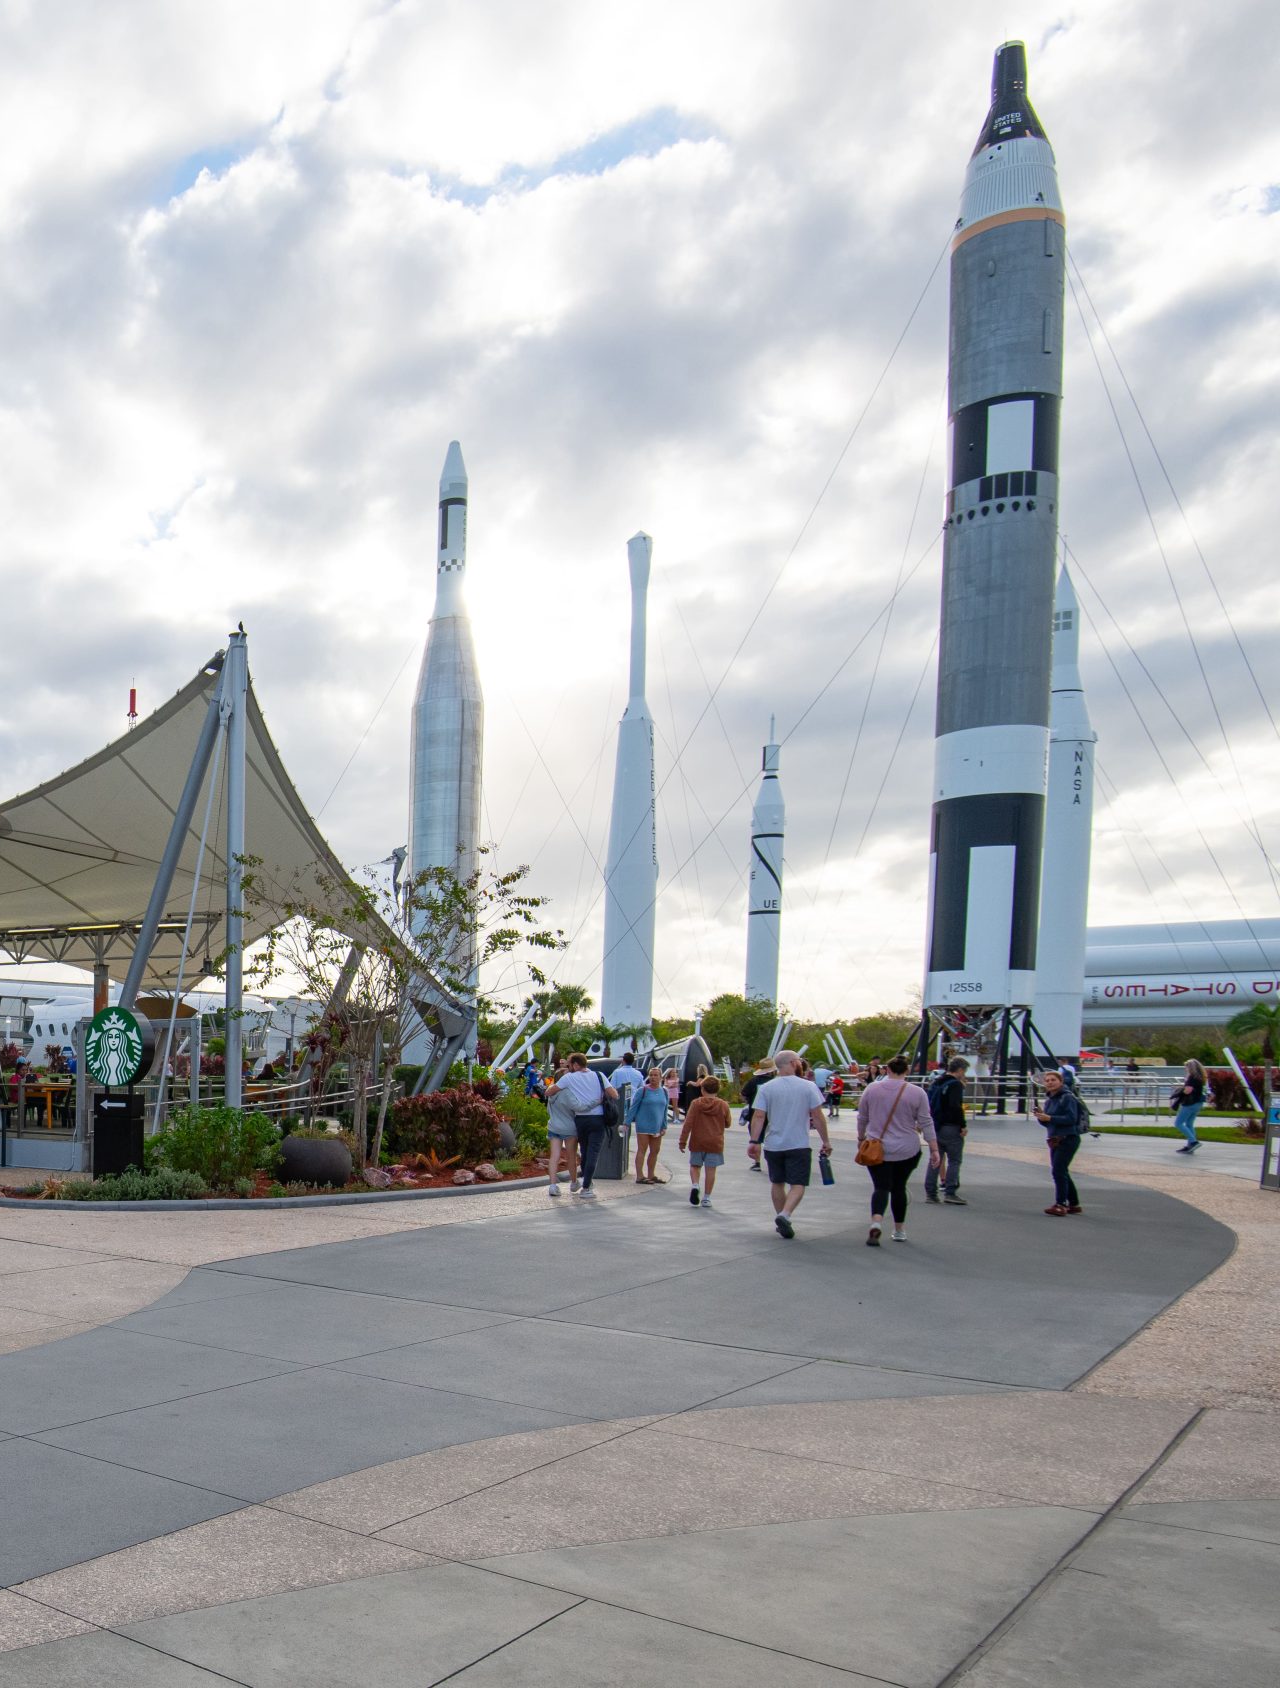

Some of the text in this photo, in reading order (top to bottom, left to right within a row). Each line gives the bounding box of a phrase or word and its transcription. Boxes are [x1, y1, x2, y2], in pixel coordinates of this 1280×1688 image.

[992, 117, 1022, 130] STATES
[994, 112, 1022, 124] UNITED
[1072, 750, 1083, 805] NASA
[763, 899, 778, 909] UE
[949, 982, 983, 993] 12558
[1104, 982, 1236, 998] STATES
